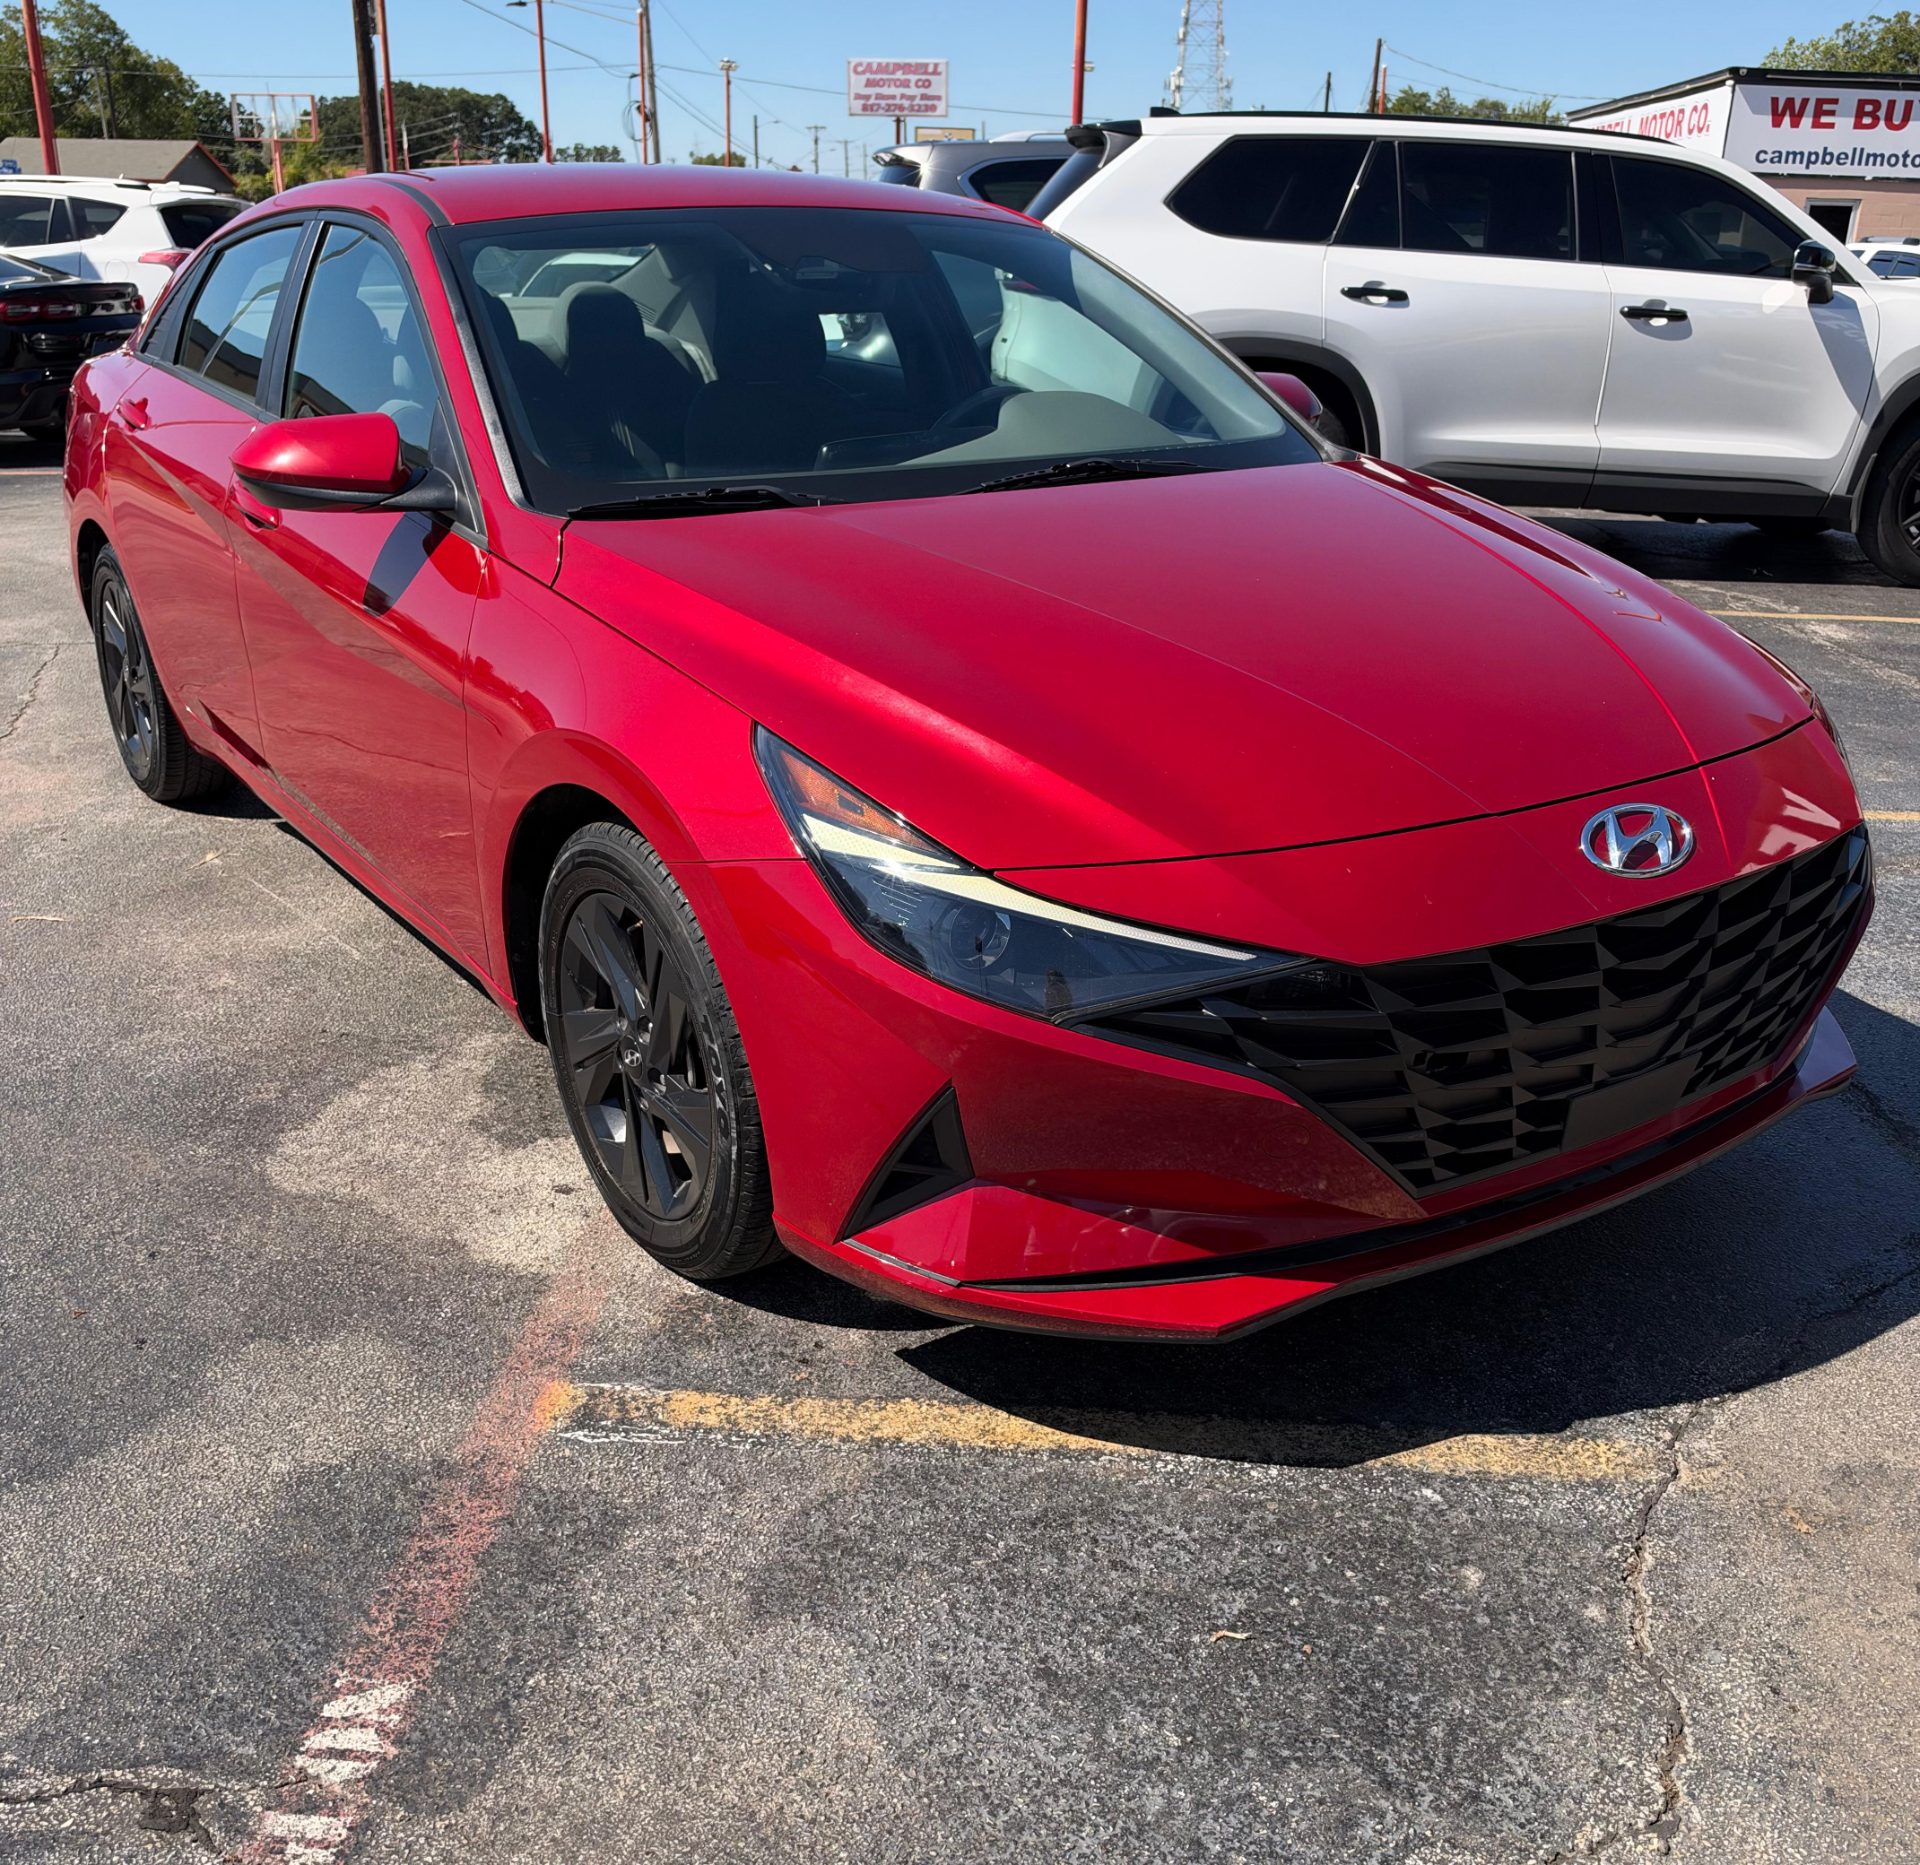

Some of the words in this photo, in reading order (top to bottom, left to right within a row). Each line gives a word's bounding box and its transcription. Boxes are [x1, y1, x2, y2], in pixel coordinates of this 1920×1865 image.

[853, 62, 942, 76] CAMPBELL
[864, 78, 911, 88] MOTOR
[914, 78, 932, 89] CO
[1640, 108, 1685, 139] MOTOR
[1687, 103, 1710, 135] CO.
[1770, 96, 1839, 129] WE
[1852, 98, 1920, 132] BU
